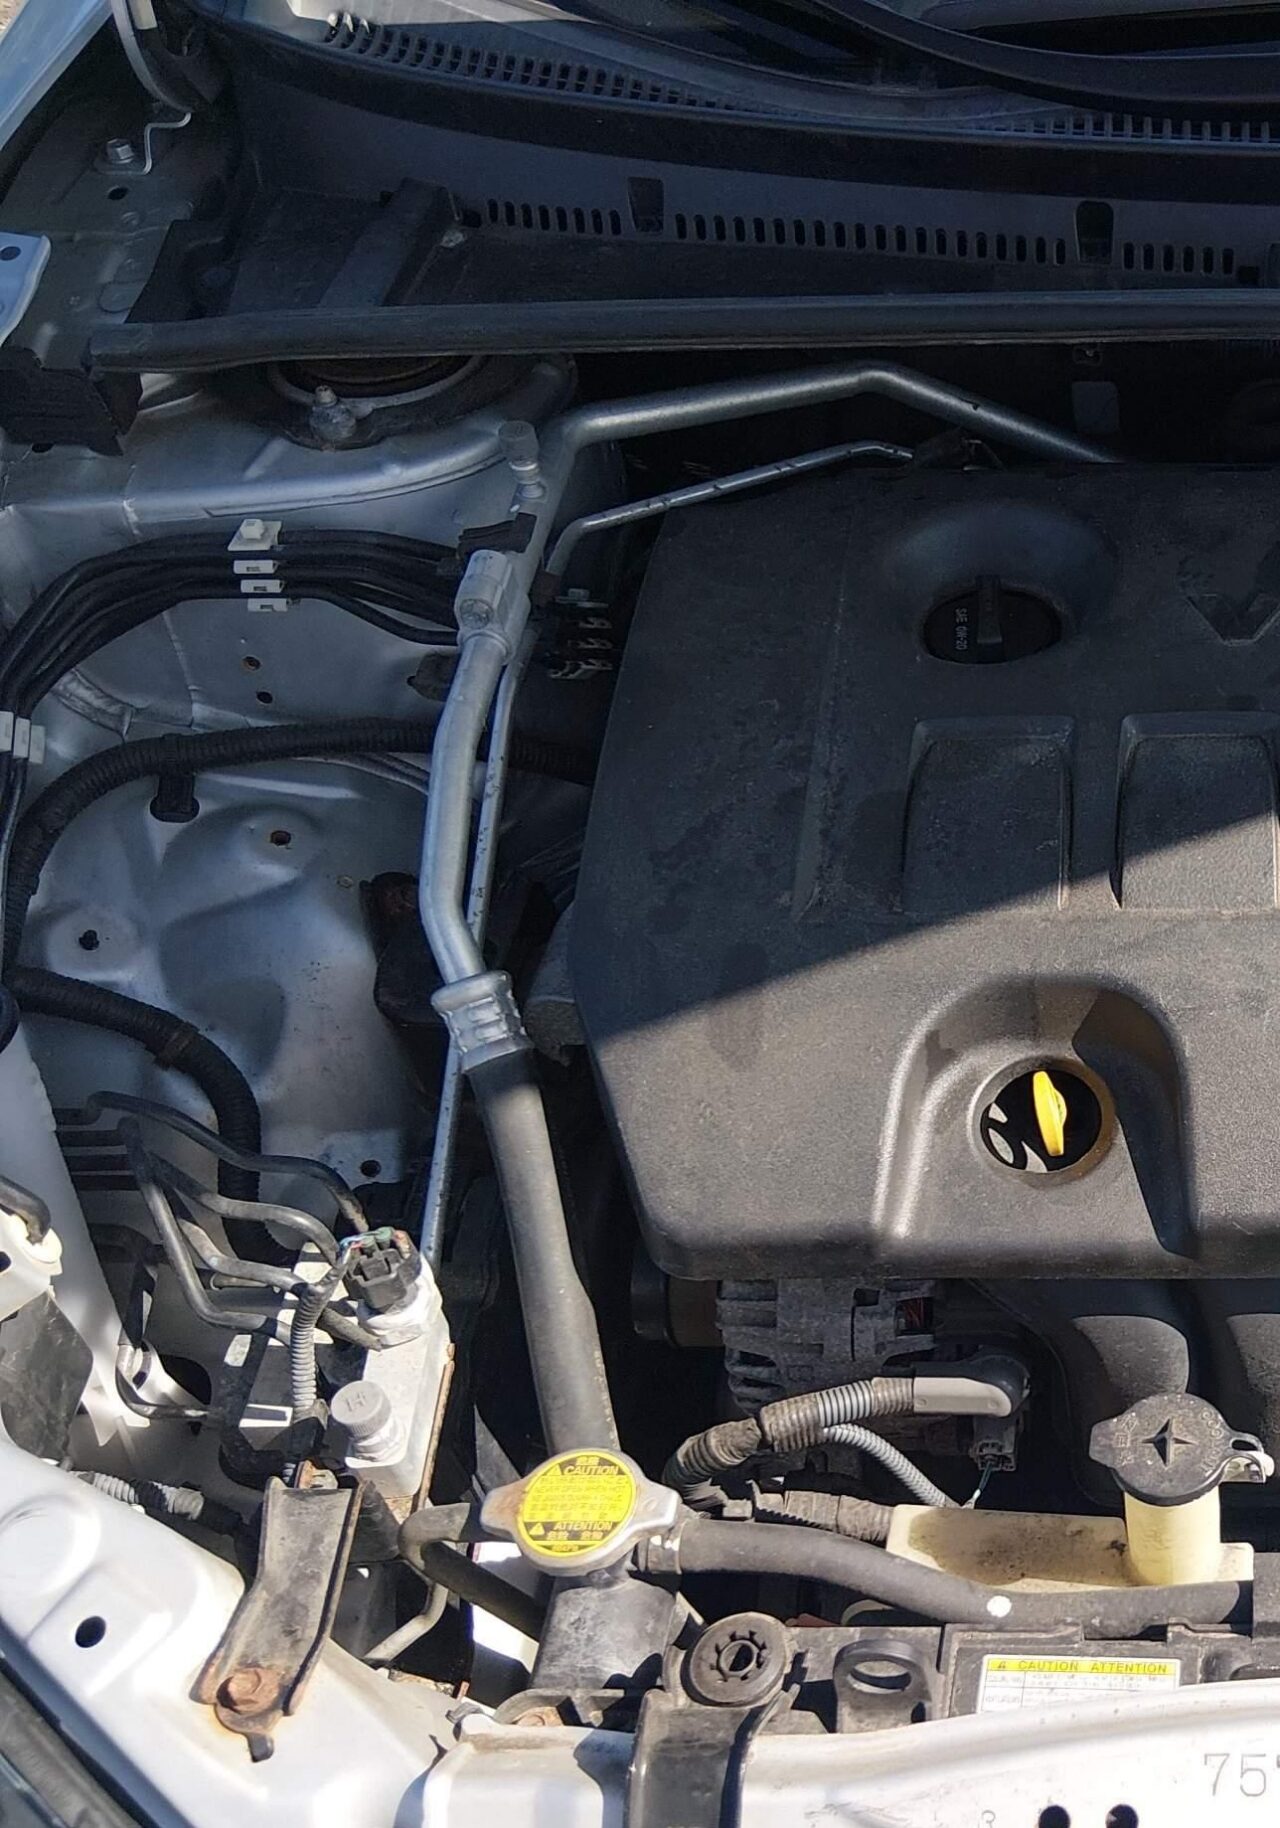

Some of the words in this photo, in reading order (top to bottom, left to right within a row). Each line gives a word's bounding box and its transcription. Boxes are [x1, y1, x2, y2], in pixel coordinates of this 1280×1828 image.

[562, 1465, 619, 1475] CAUTION
[553, 1521, 614, 1531] ATTENTION
[1018, 1659, 1079, 1671] CAUTION
[1091, 1661, 1167, 1674] ATTENTION
